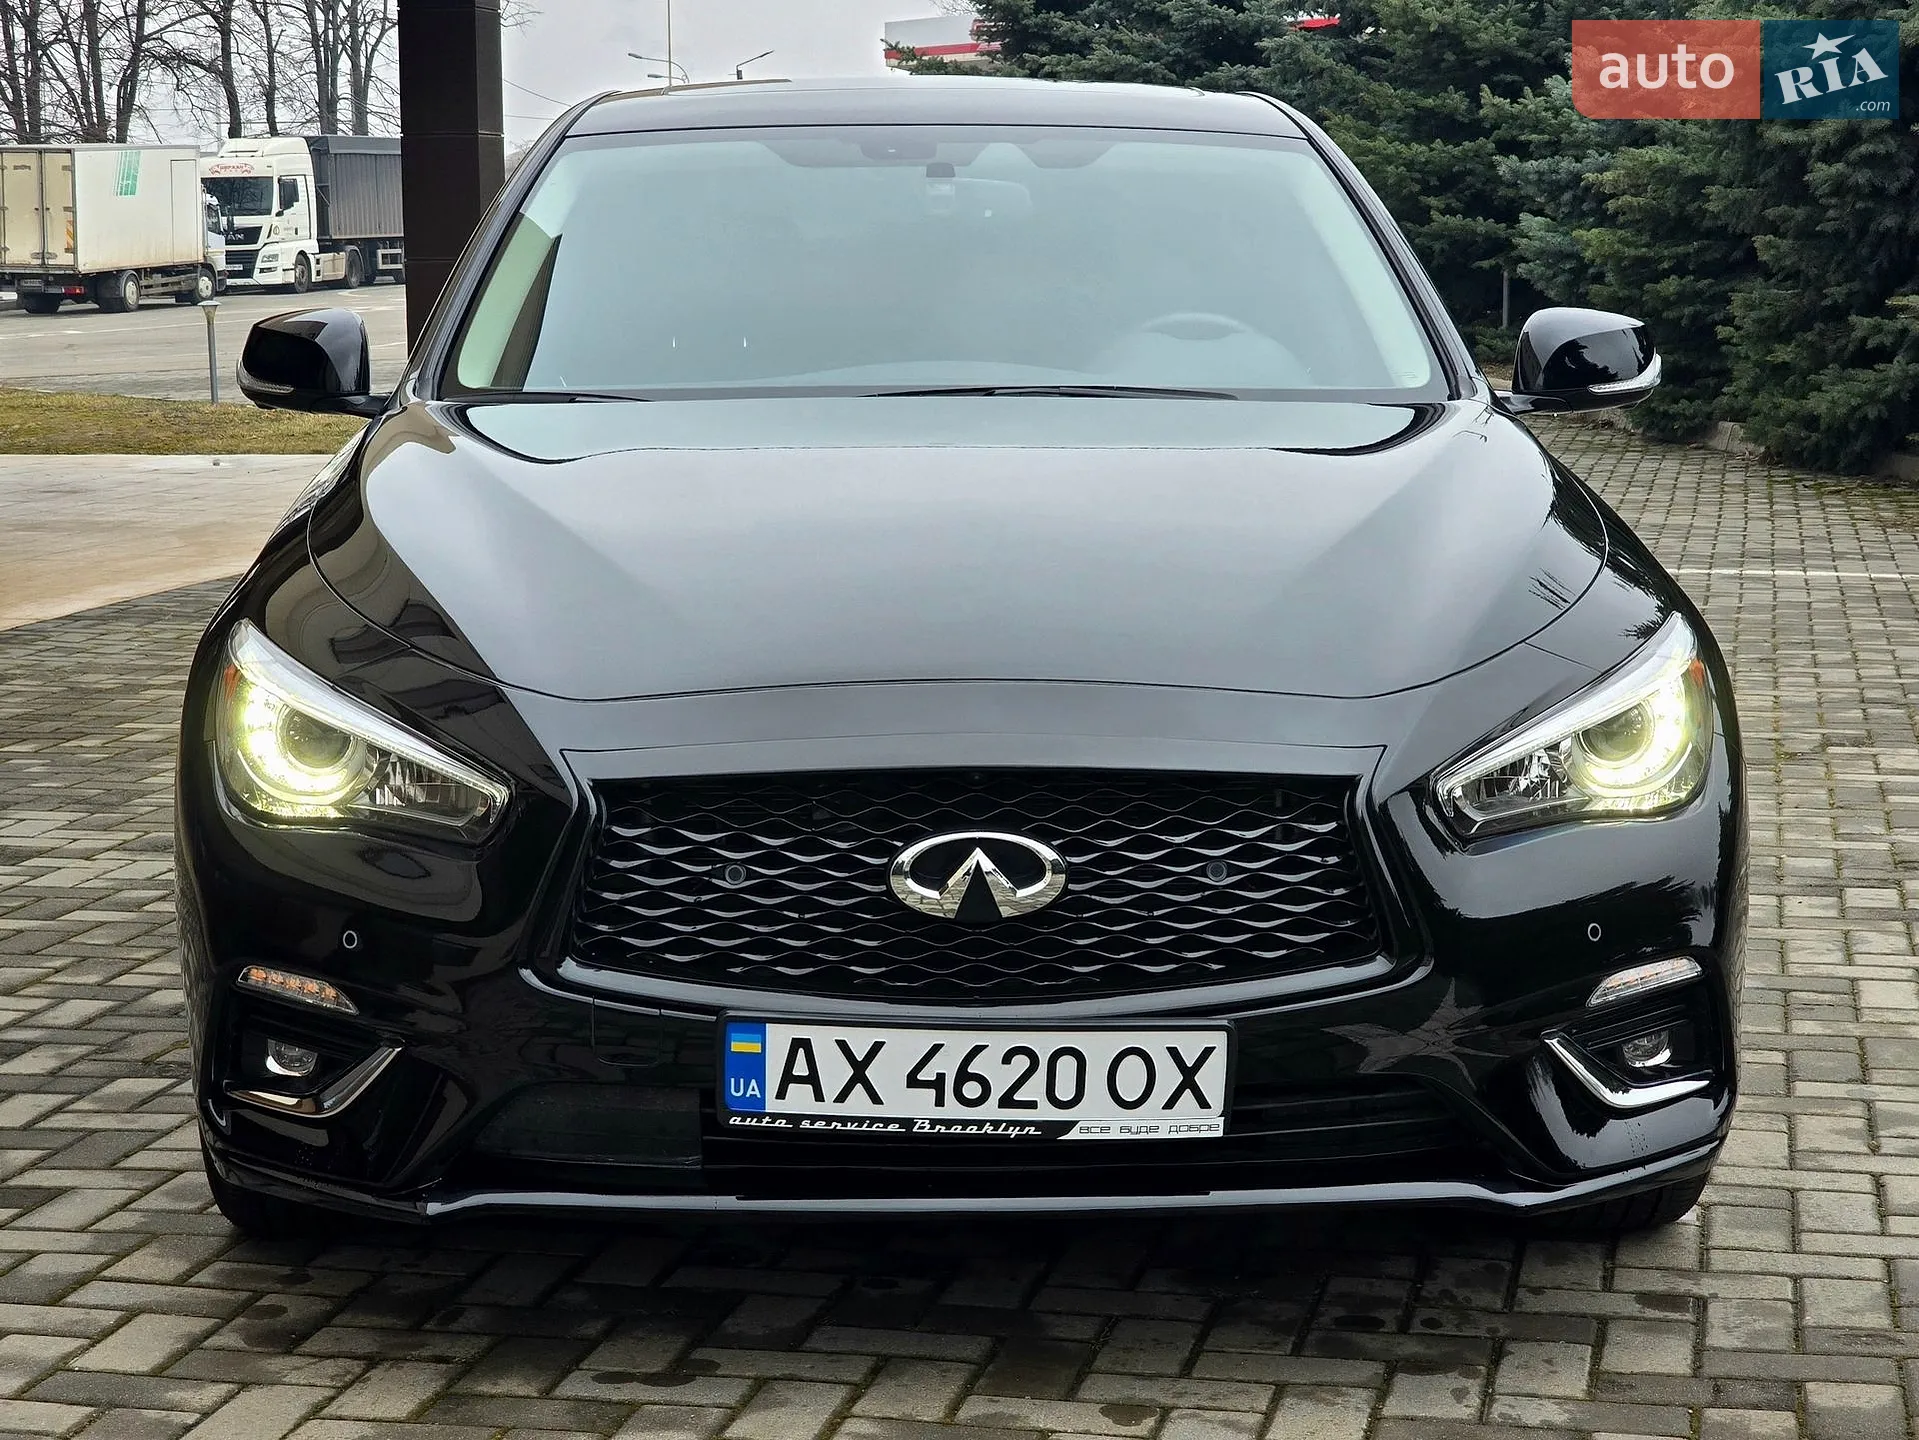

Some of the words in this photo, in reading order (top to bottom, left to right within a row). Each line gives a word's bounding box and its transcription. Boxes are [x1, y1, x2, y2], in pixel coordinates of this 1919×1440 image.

[774, 1037, 887, 1106] AX
[905, 1042, 1088, 1111] 4620
[1106, 1046, 1217, 1111] OX
[730, 1077, 762, 1099] UA
[729, 1115, 793, 1128] auto
[799, 1120, 906, 1132] service
[912, 1119, 1042, 1138] Brooklyn
